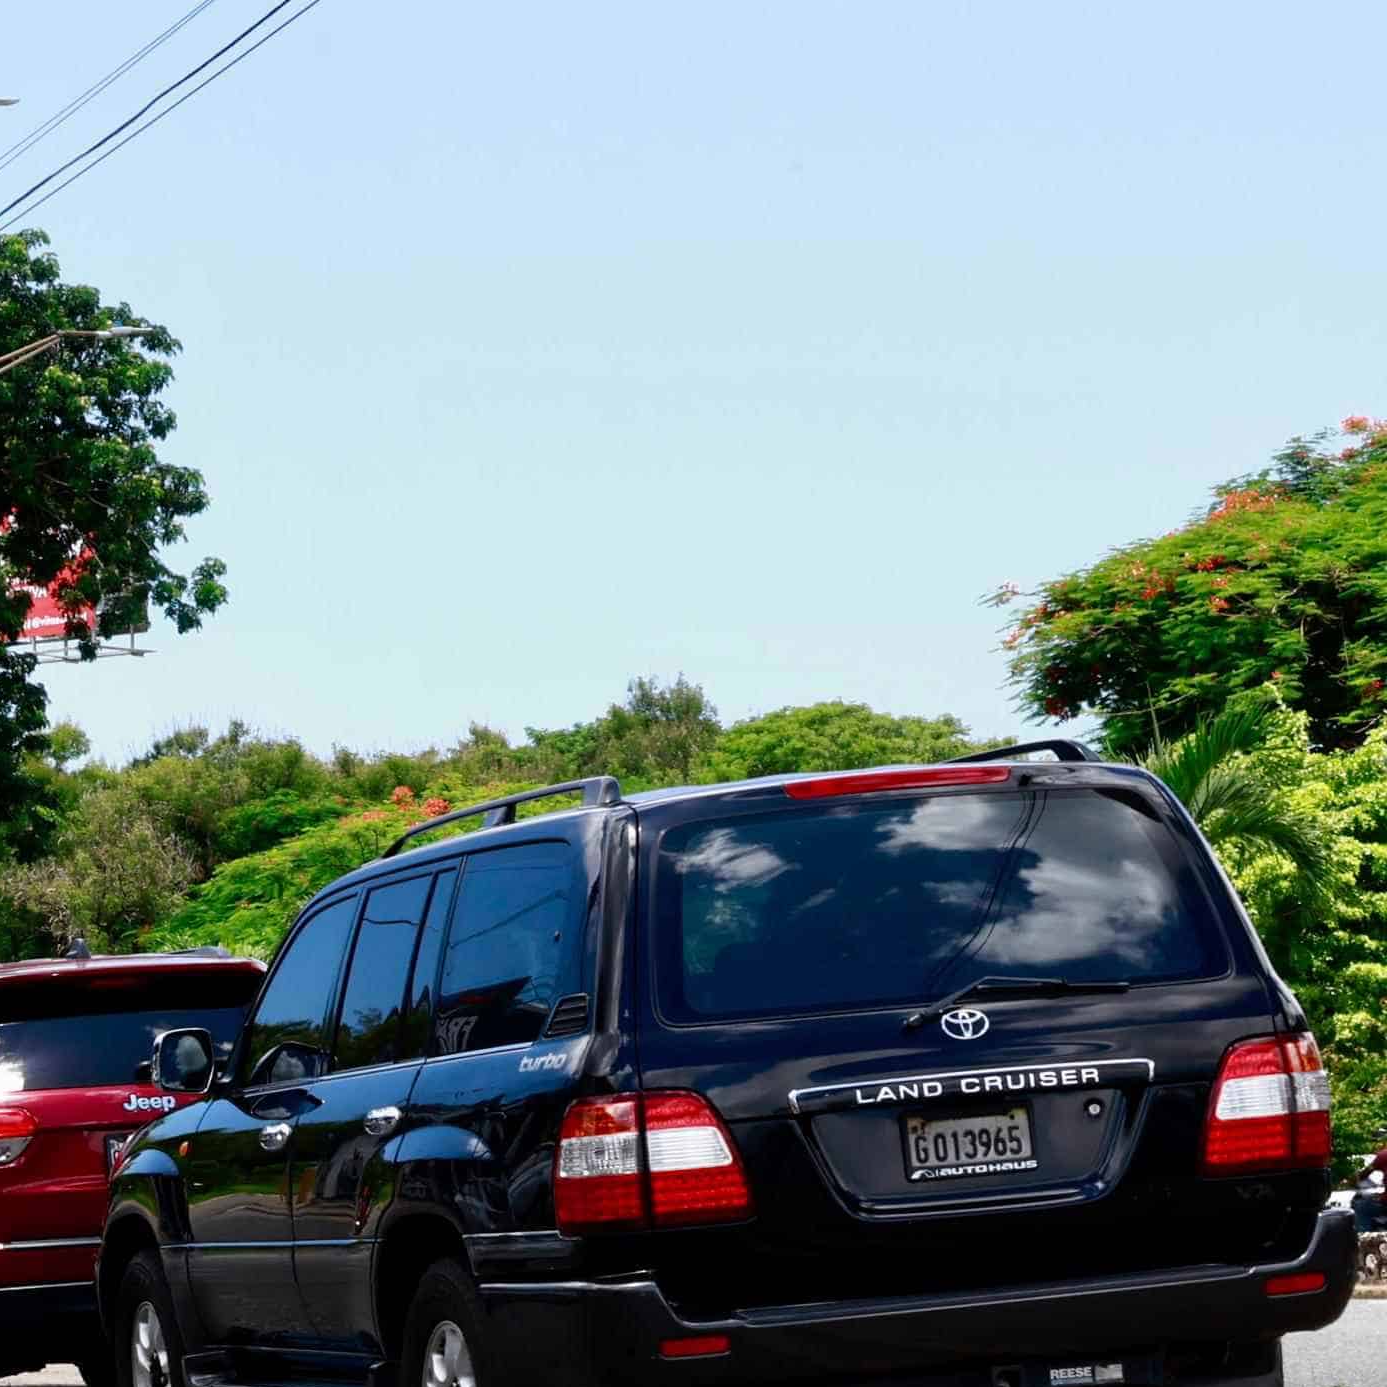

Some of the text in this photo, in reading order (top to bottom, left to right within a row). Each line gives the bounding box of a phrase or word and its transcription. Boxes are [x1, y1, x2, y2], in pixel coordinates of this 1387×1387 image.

[520, 1053, 567, 1072] turbo
[856, 1068, 1100, 1104] LAND CRUISER
[123, 1094, 176, 1111] Jeep
[914, 1126, 1022, 1164] G013965
[1050, 1366, 1092, 1379] REESE
